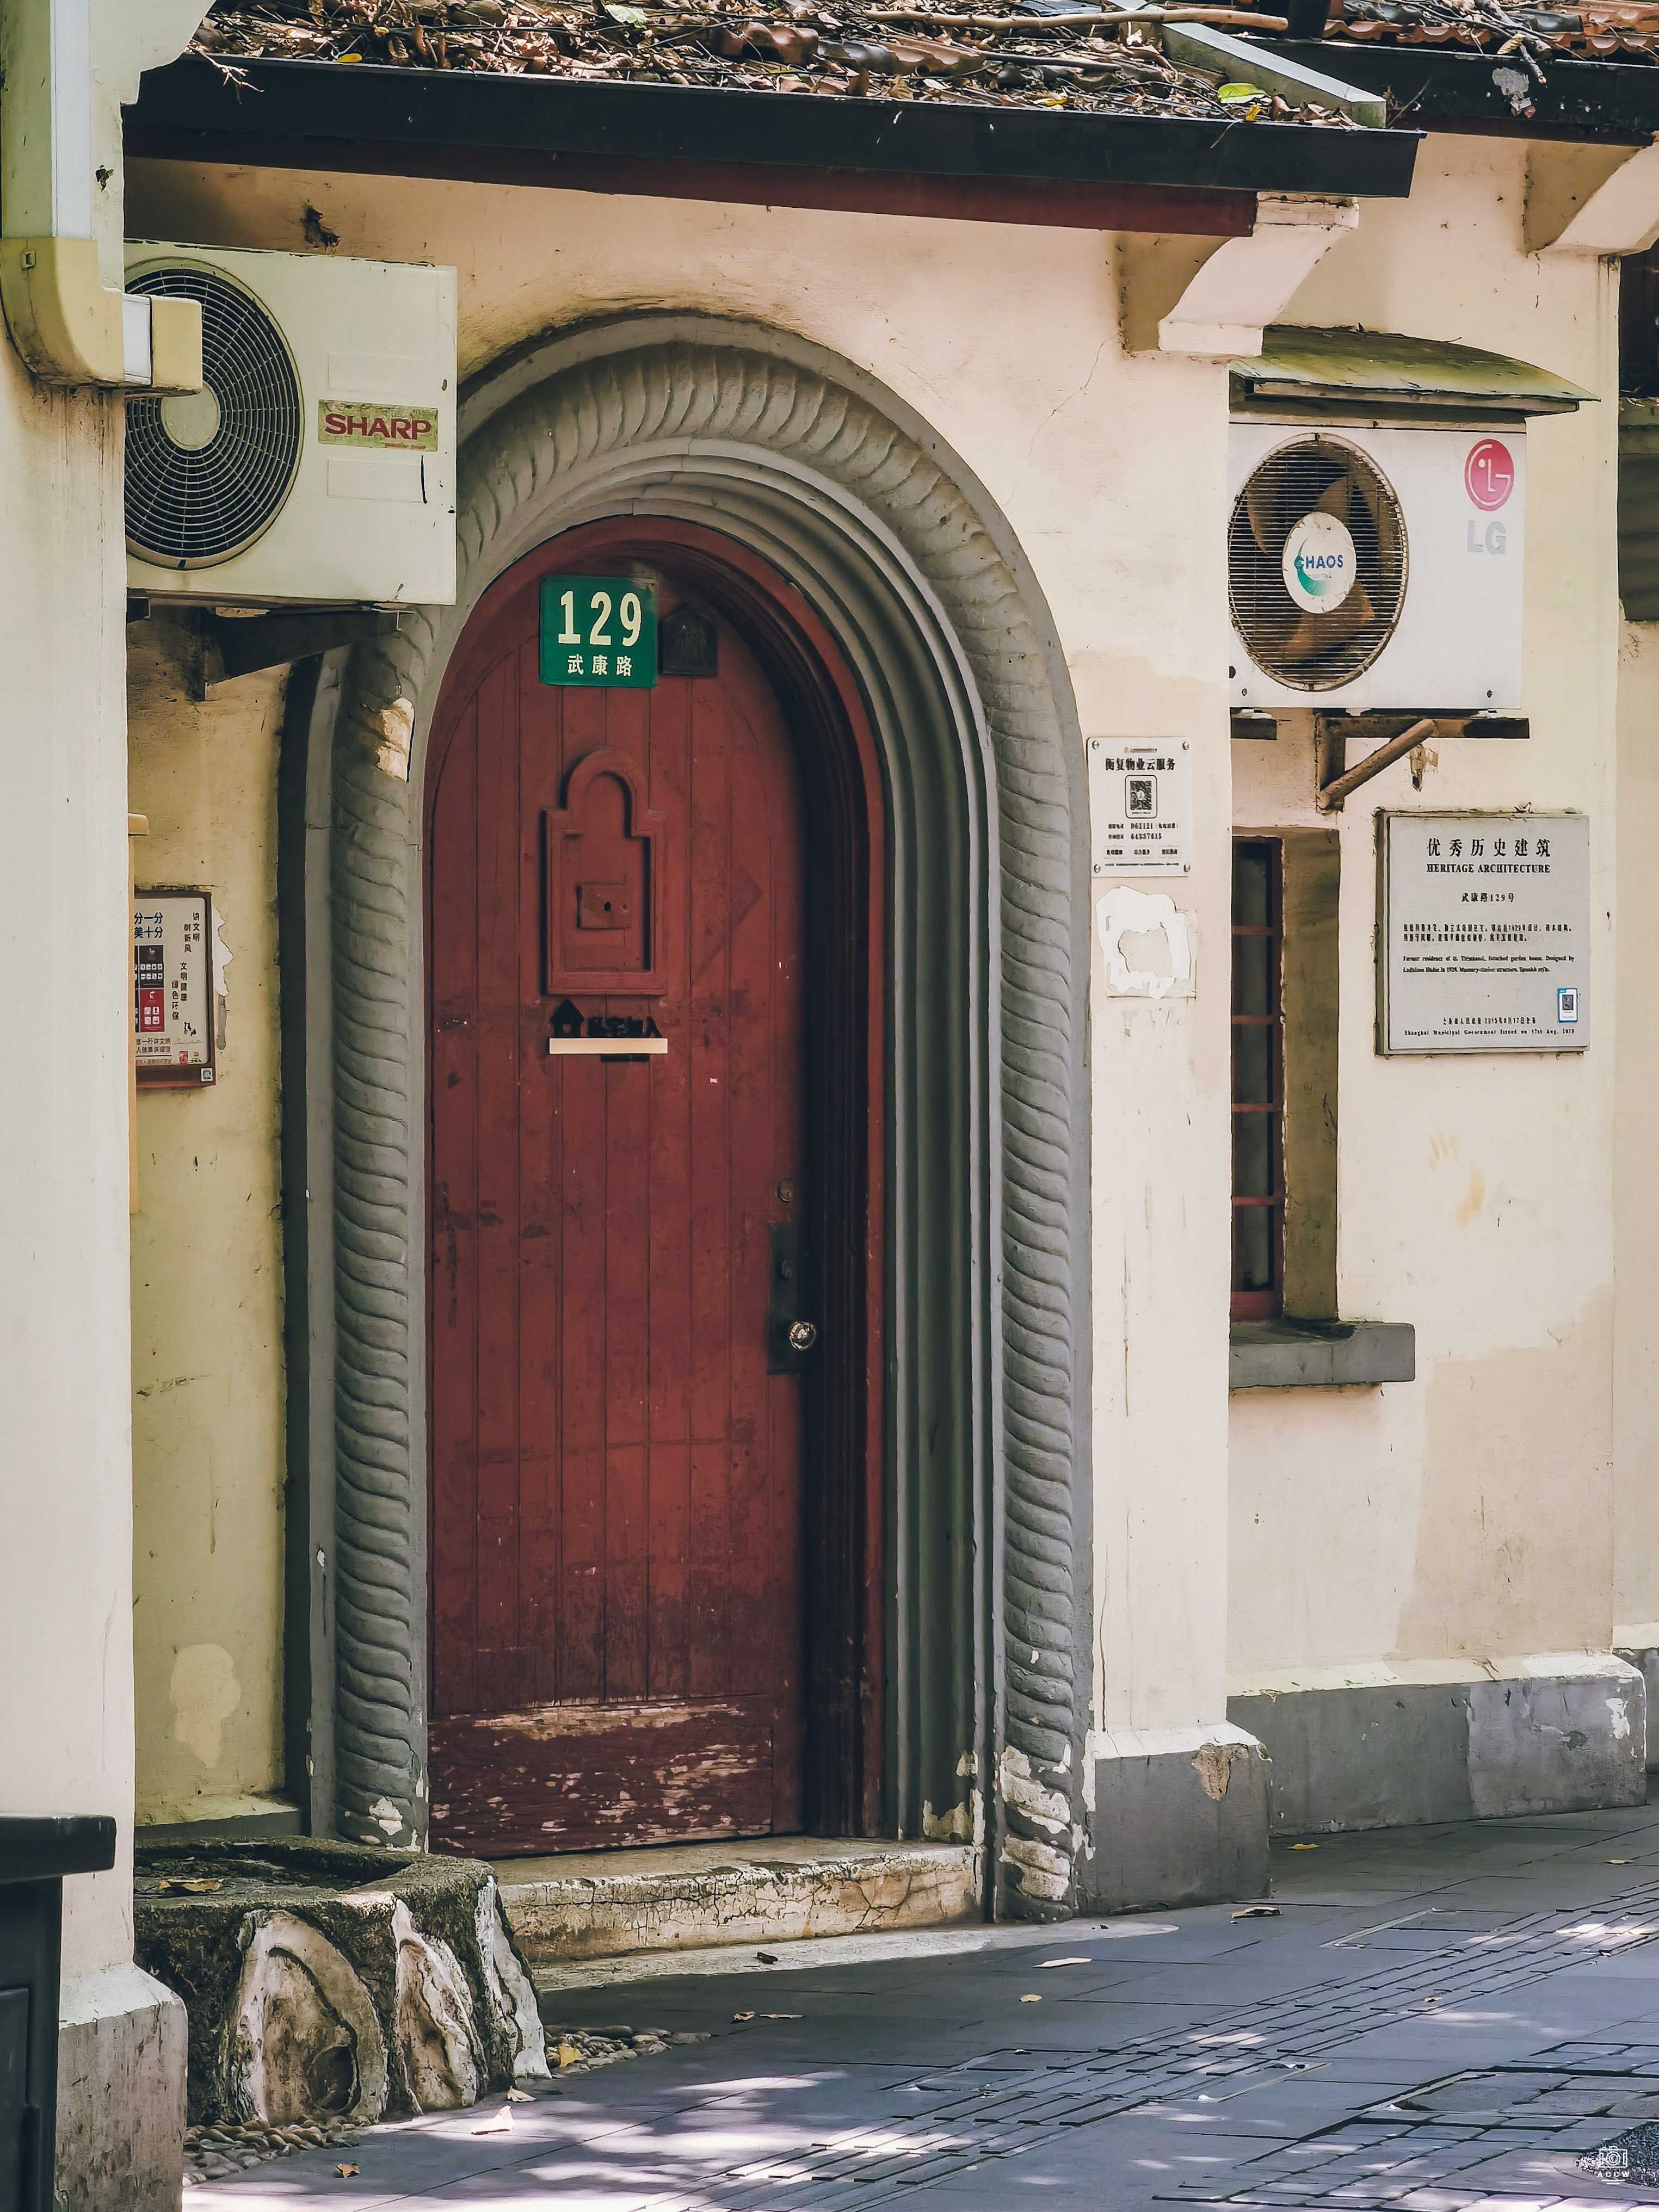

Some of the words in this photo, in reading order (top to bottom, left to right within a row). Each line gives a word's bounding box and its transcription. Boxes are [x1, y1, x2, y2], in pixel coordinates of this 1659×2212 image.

[325, 413, 431, 440] SHARP
[1467, 520, 1506, 554] LG
[558, 591, 642, 646] 129
[568, 654, 632, 676] 武康路
[1105, 758, 1175, 770] 衡复物业云服务
[1427, 838, 1550, 857] 优秀历史建筑
[1427, 863, 1474, 873] HERITAGE
[1477, 863, 1550, 873] ARCHITECTURE
[1461, 892, 1514, 903] 武康路129号
